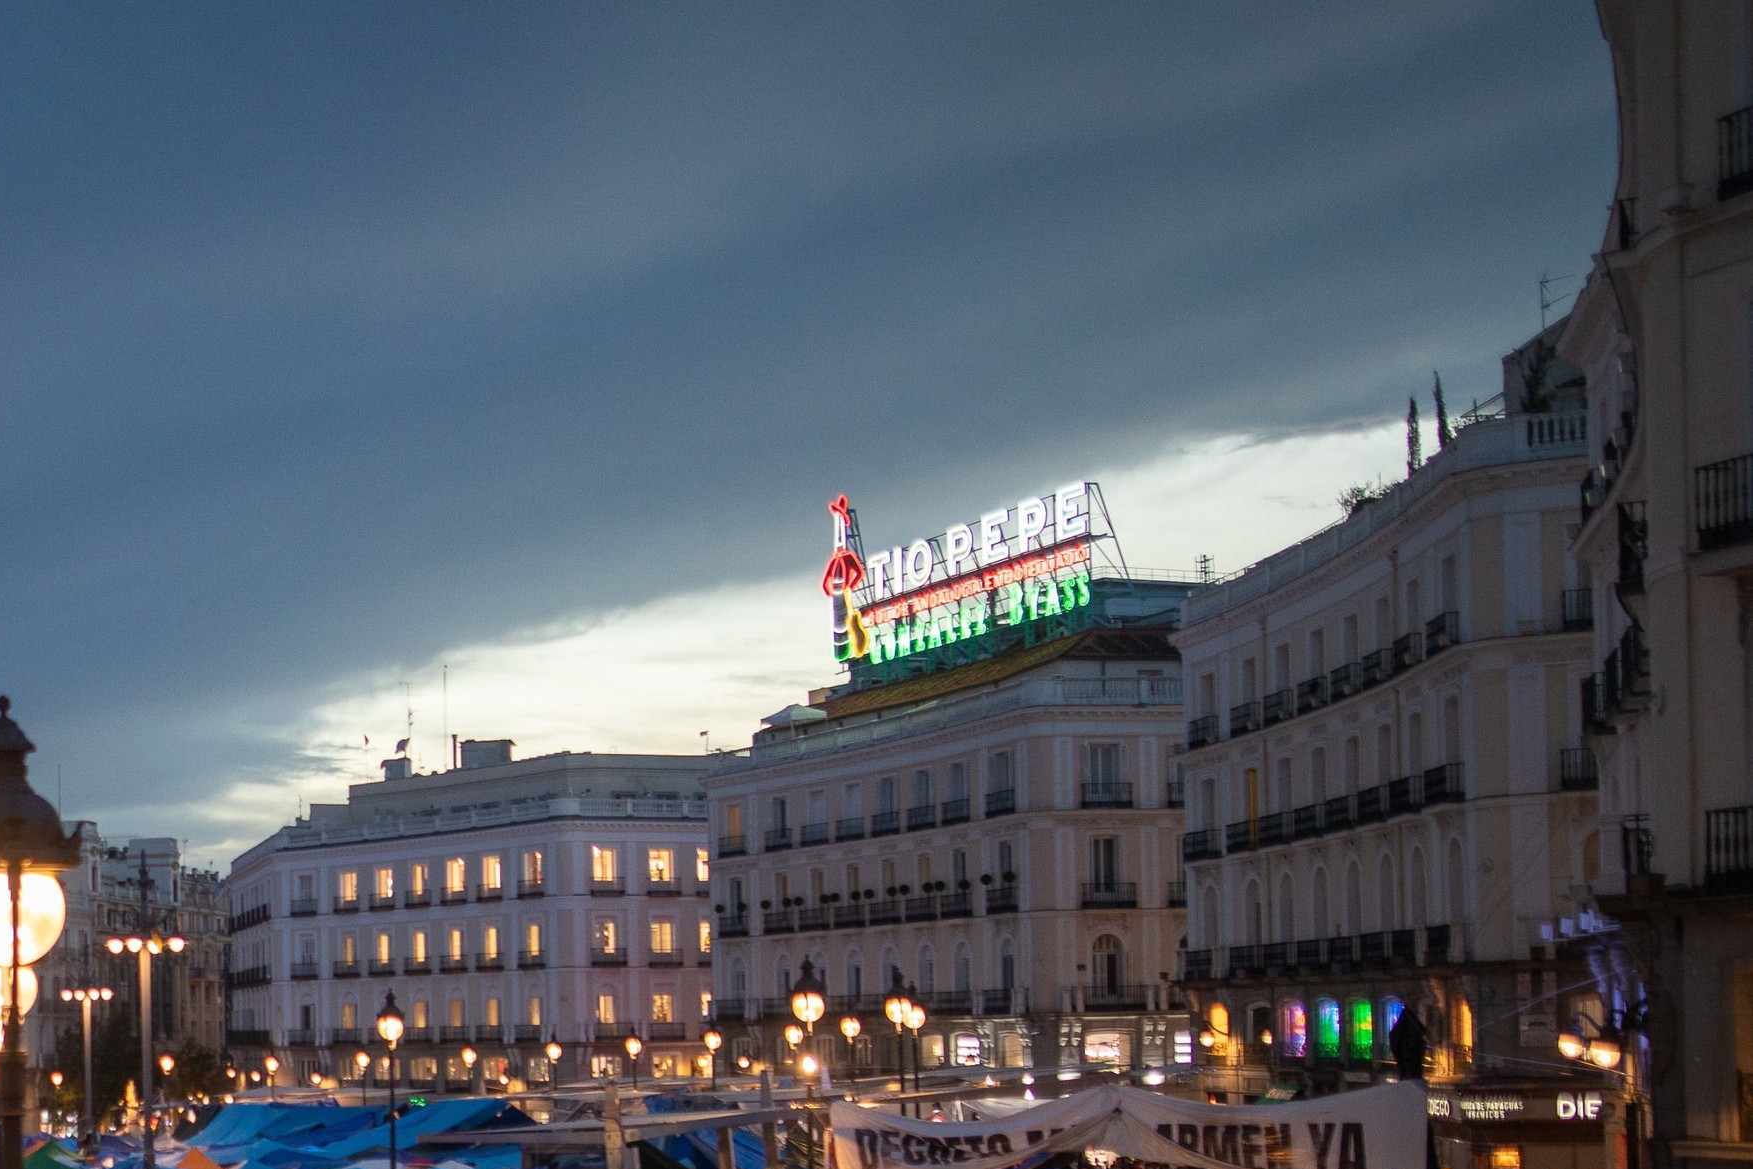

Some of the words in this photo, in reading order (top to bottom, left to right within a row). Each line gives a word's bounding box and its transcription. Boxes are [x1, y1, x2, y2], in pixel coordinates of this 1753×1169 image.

[866, 537, 933, 600] TIO
[947, 480, 1089, 576] PEPE
[1009, 572, 1090, 626] BYASS
